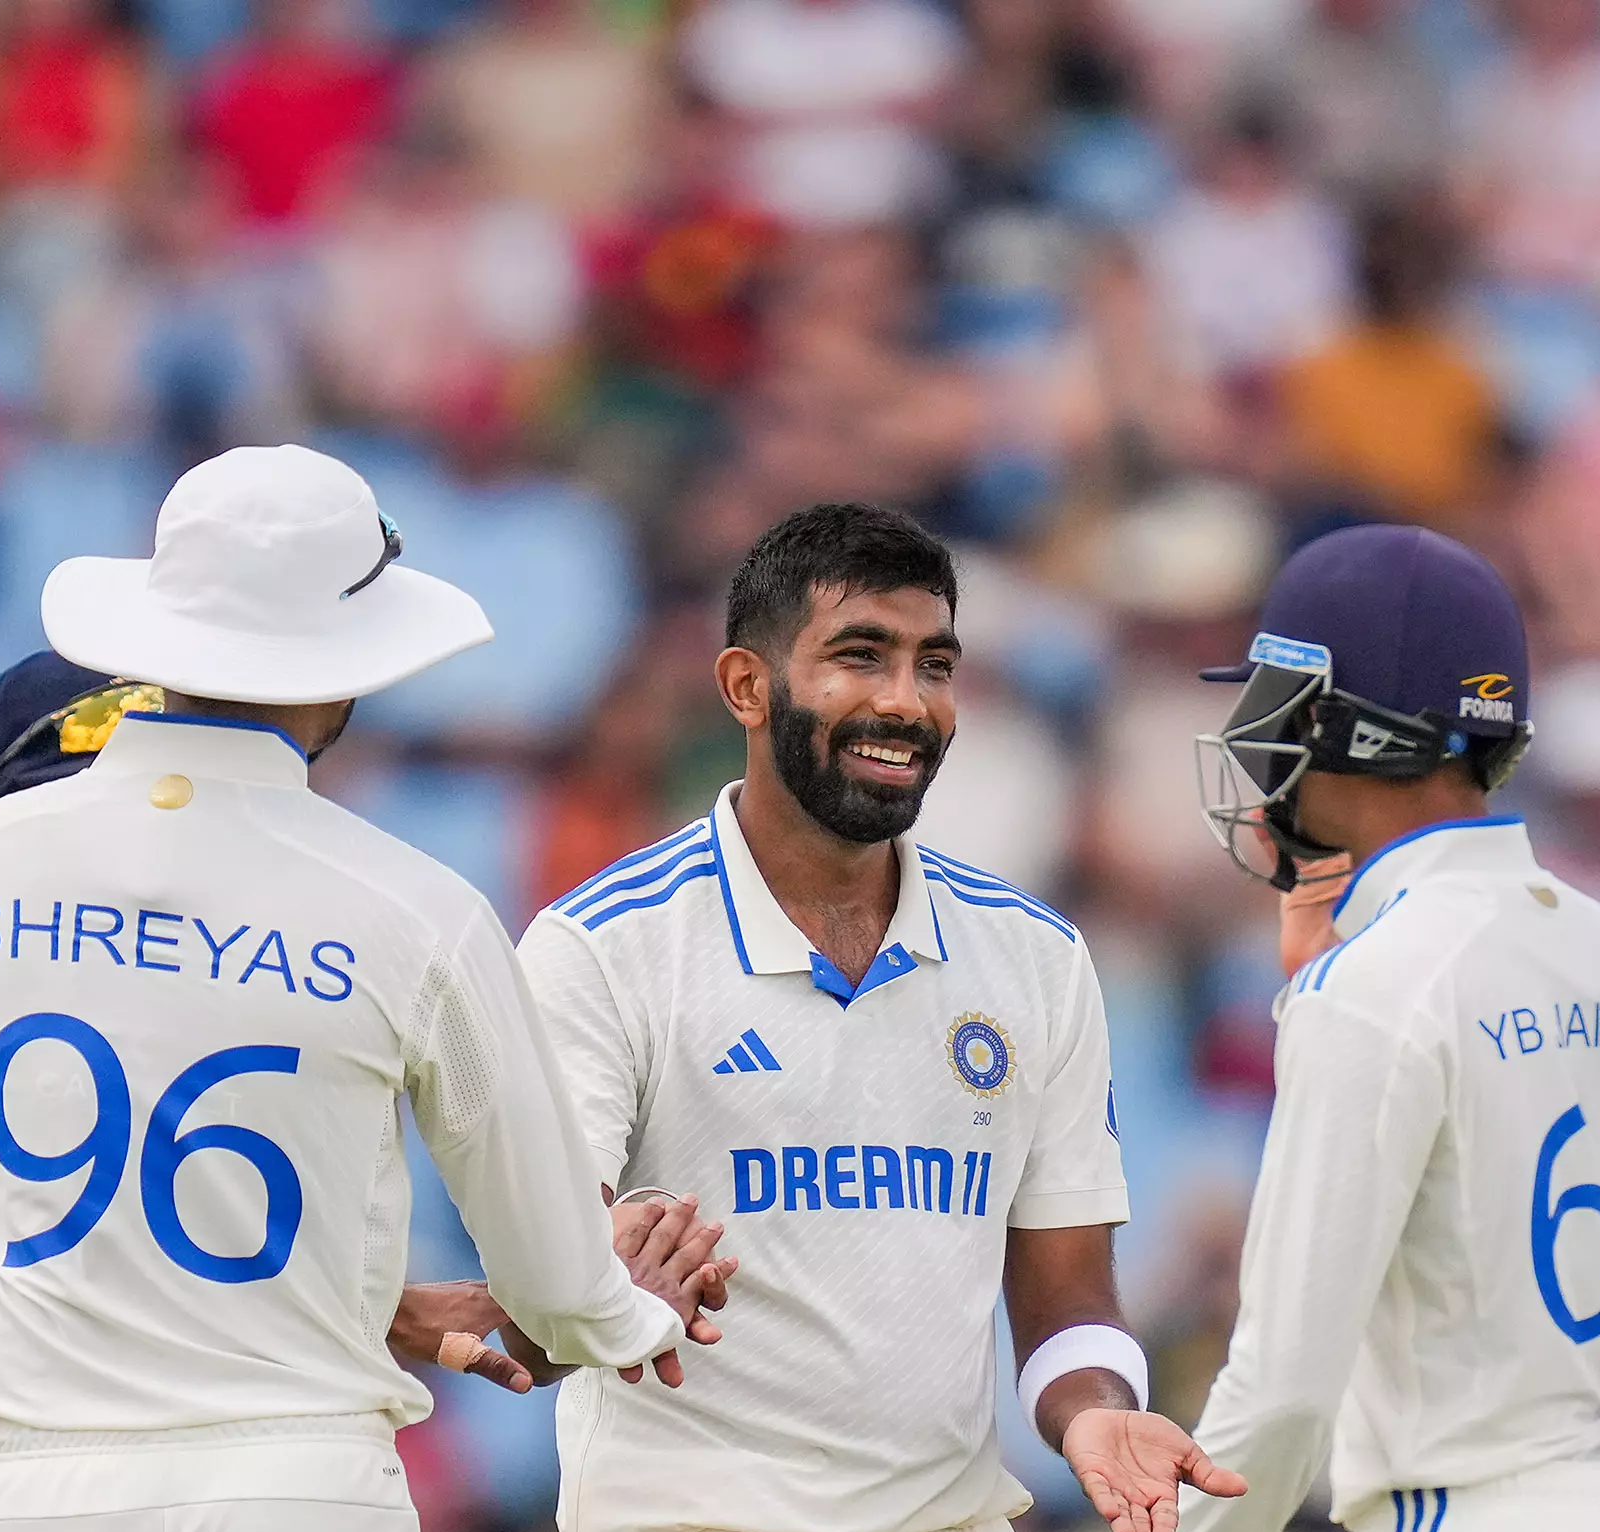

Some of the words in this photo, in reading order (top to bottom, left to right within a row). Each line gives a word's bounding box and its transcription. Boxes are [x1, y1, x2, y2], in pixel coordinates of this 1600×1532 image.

[1479, 1008, 1543, 1060] YB
[972, 1111, 992, 1126] 290
[730, 1145, 992, 1217] DREAM11
